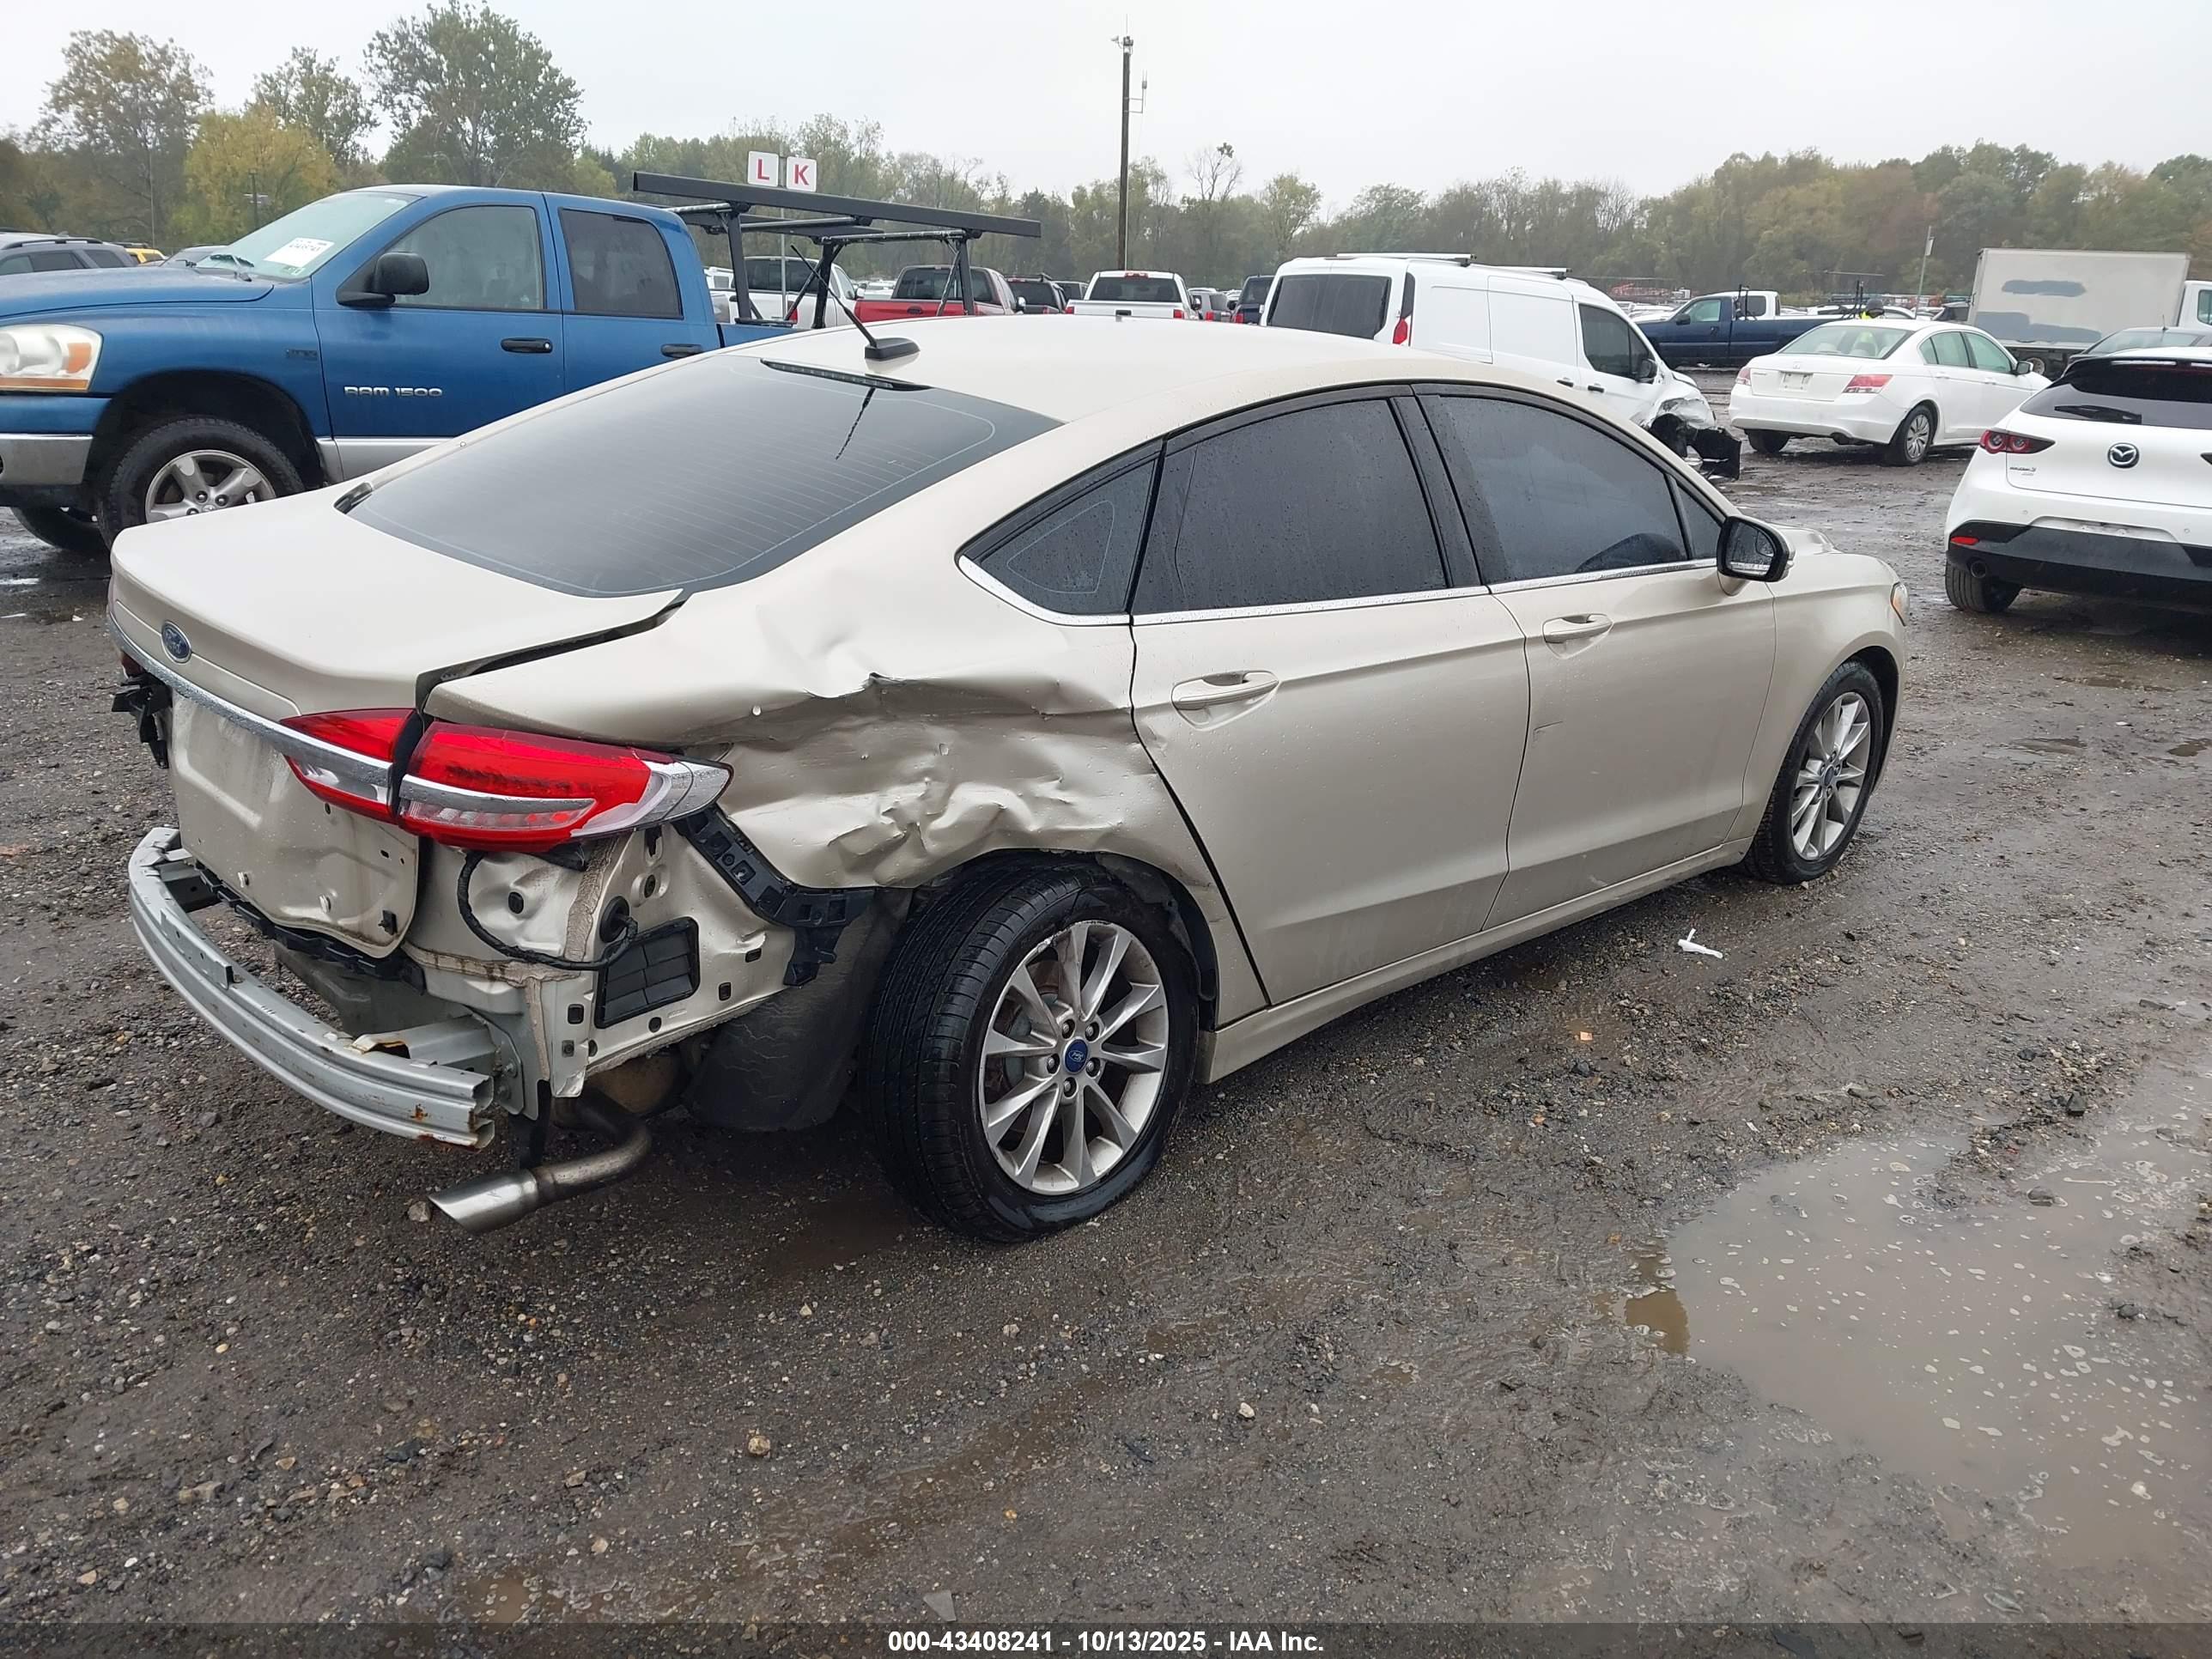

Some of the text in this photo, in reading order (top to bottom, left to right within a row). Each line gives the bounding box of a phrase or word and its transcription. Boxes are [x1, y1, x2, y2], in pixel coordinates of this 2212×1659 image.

[757, 159, 770, 180] L
[794, 164, 810, 185] K
[343, 386, 443, 398] RAM 1500
